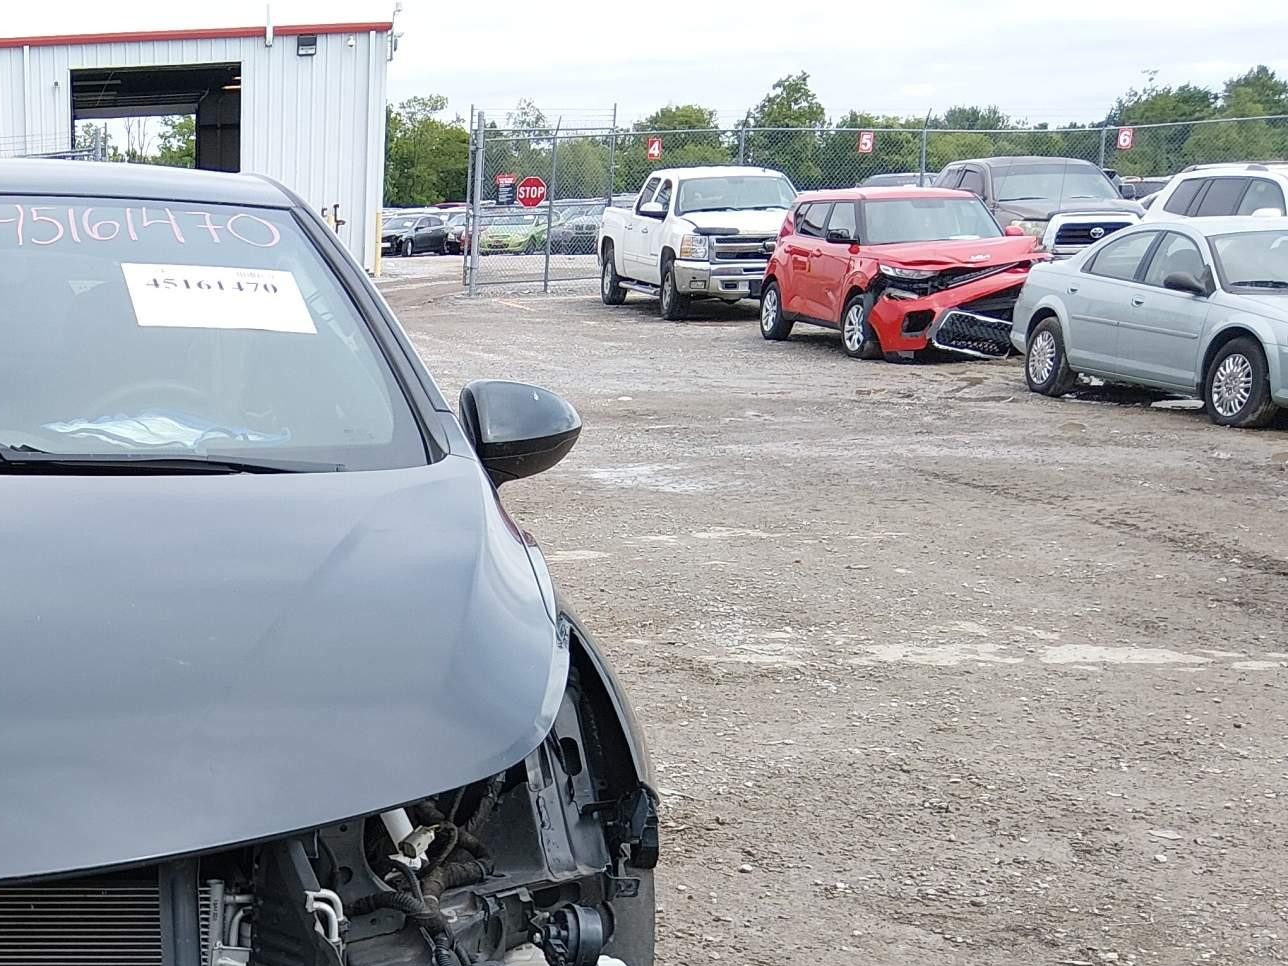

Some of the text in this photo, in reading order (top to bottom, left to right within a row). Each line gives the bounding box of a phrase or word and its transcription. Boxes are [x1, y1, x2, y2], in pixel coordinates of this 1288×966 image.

[861, 134, 872, 150] 5
[1119, 130, 1131, 147] 6
[649, 140, 661, 157] 4
[518, 186, 545, 199] STOP
[145, 277, 278, 295] 45161470
